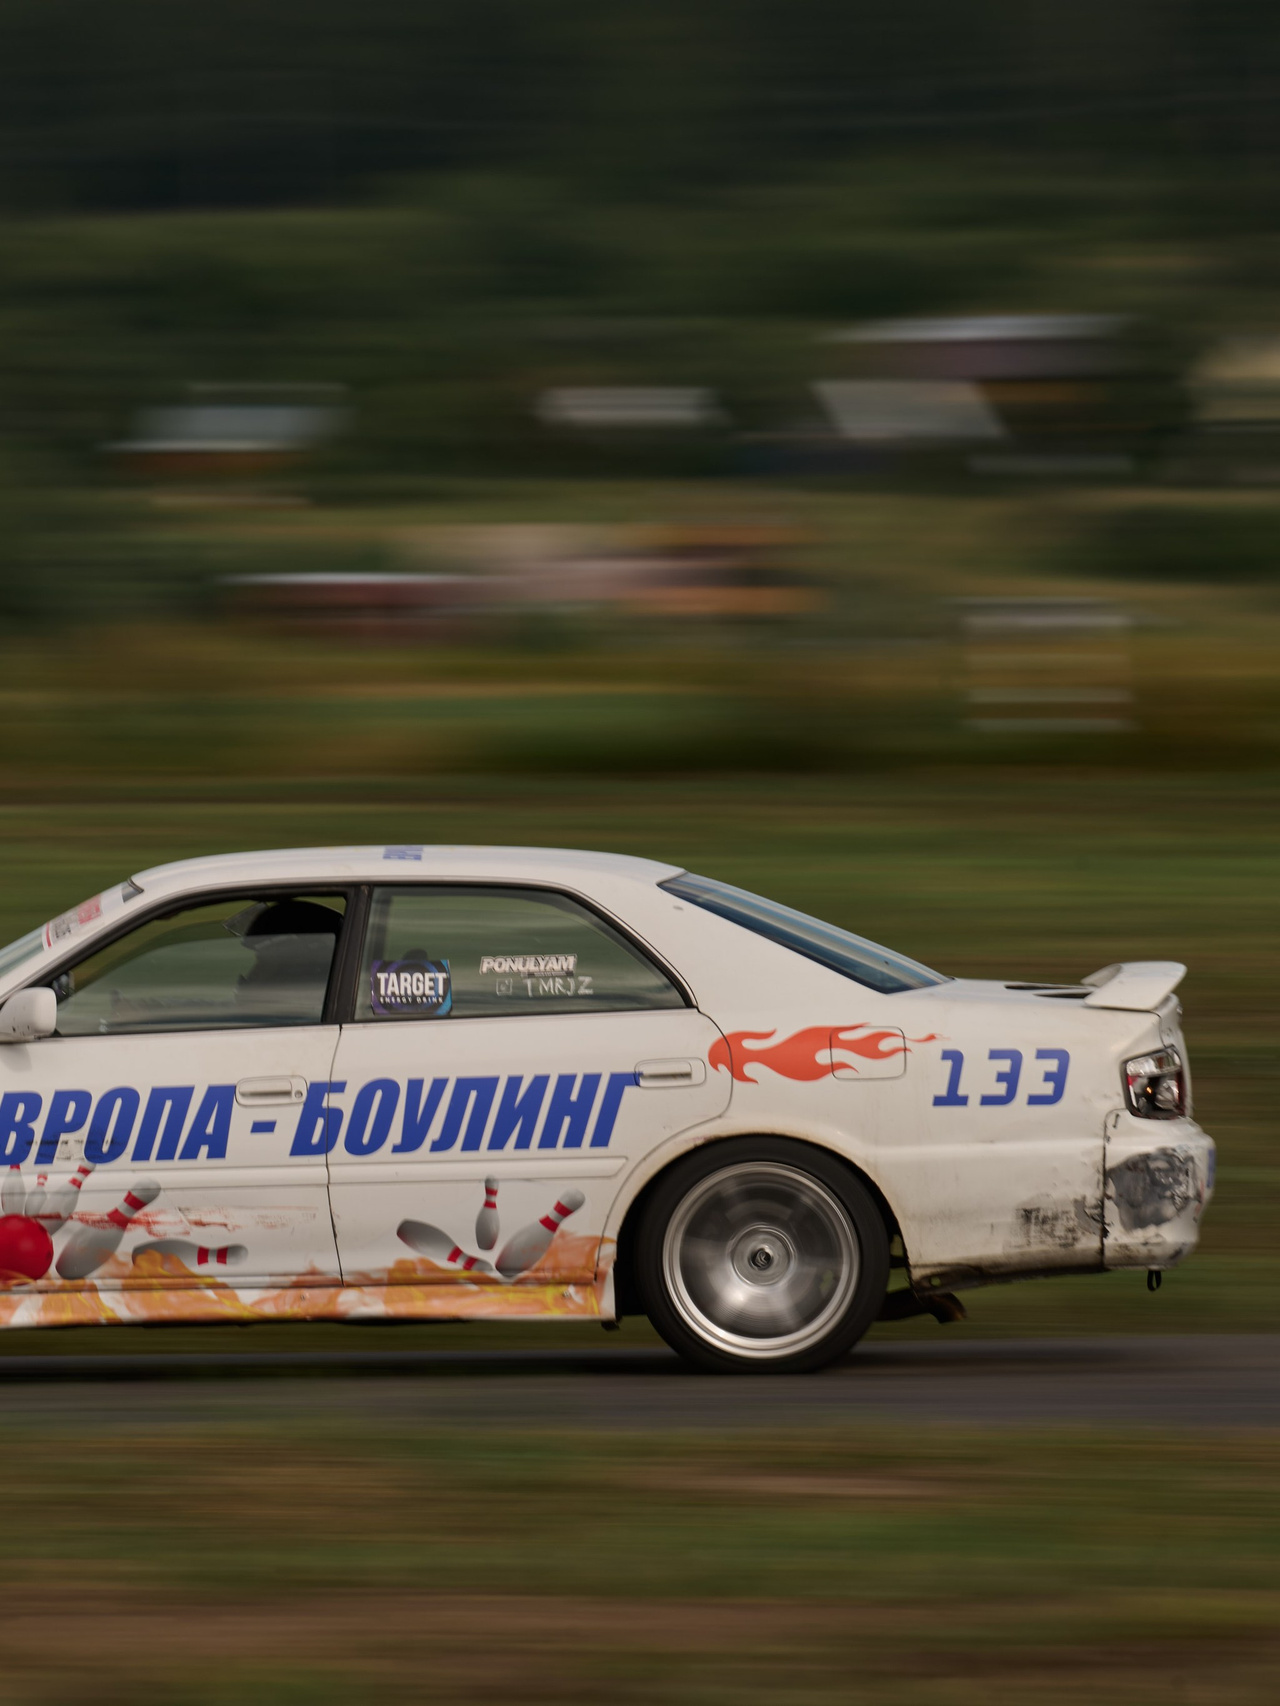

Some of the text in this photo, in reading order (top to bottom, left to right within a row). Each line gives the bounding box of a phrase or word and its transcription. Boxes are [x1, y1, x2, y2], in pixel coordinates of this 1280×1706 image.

[377, 972, 447, 996] TARGET
[481, 955, 577, 974] PONULYAM
[932, 1048, 1070, 1107] 133
[289, 1072, 642, 1157] БОУЛИНГ
